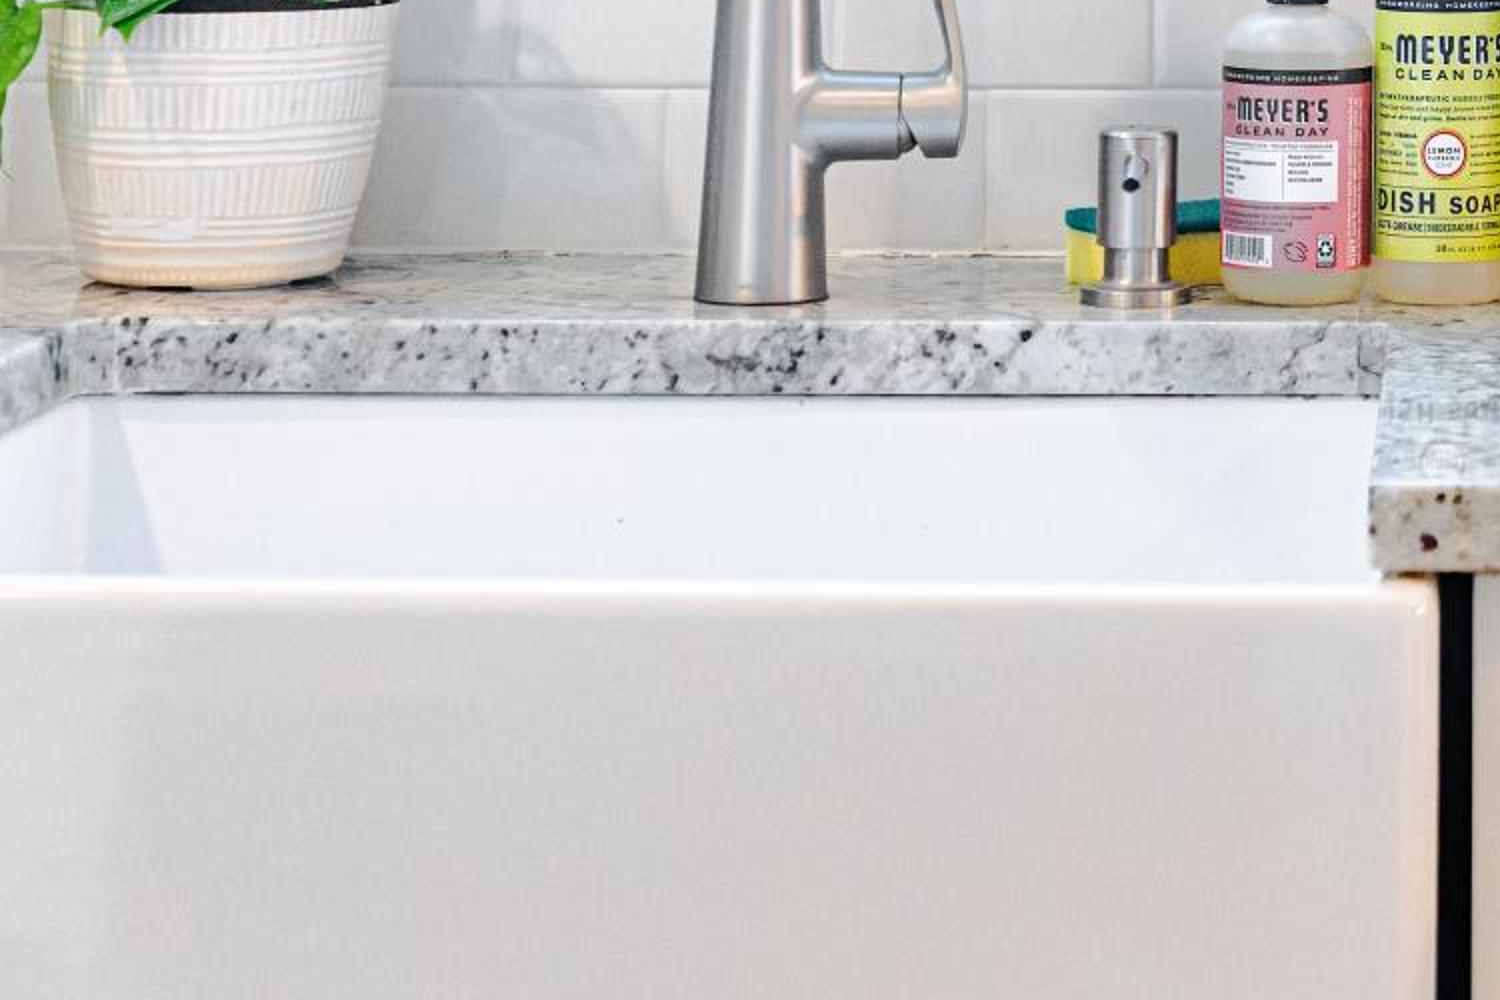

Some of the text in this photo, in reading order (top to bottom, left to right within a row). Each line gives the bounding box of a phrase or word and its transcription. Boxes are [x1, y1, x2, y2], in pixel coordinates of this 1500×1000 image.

[1395, 68, 1465, 81] CLEAN
[1237, 96, 1329, 124] MEYER'S
[1235, 125, 1330, 137] CLEAN DAY
[1427, 147, 1461, 155] LEMON
[1378, 187, 1436, 215] DISH
